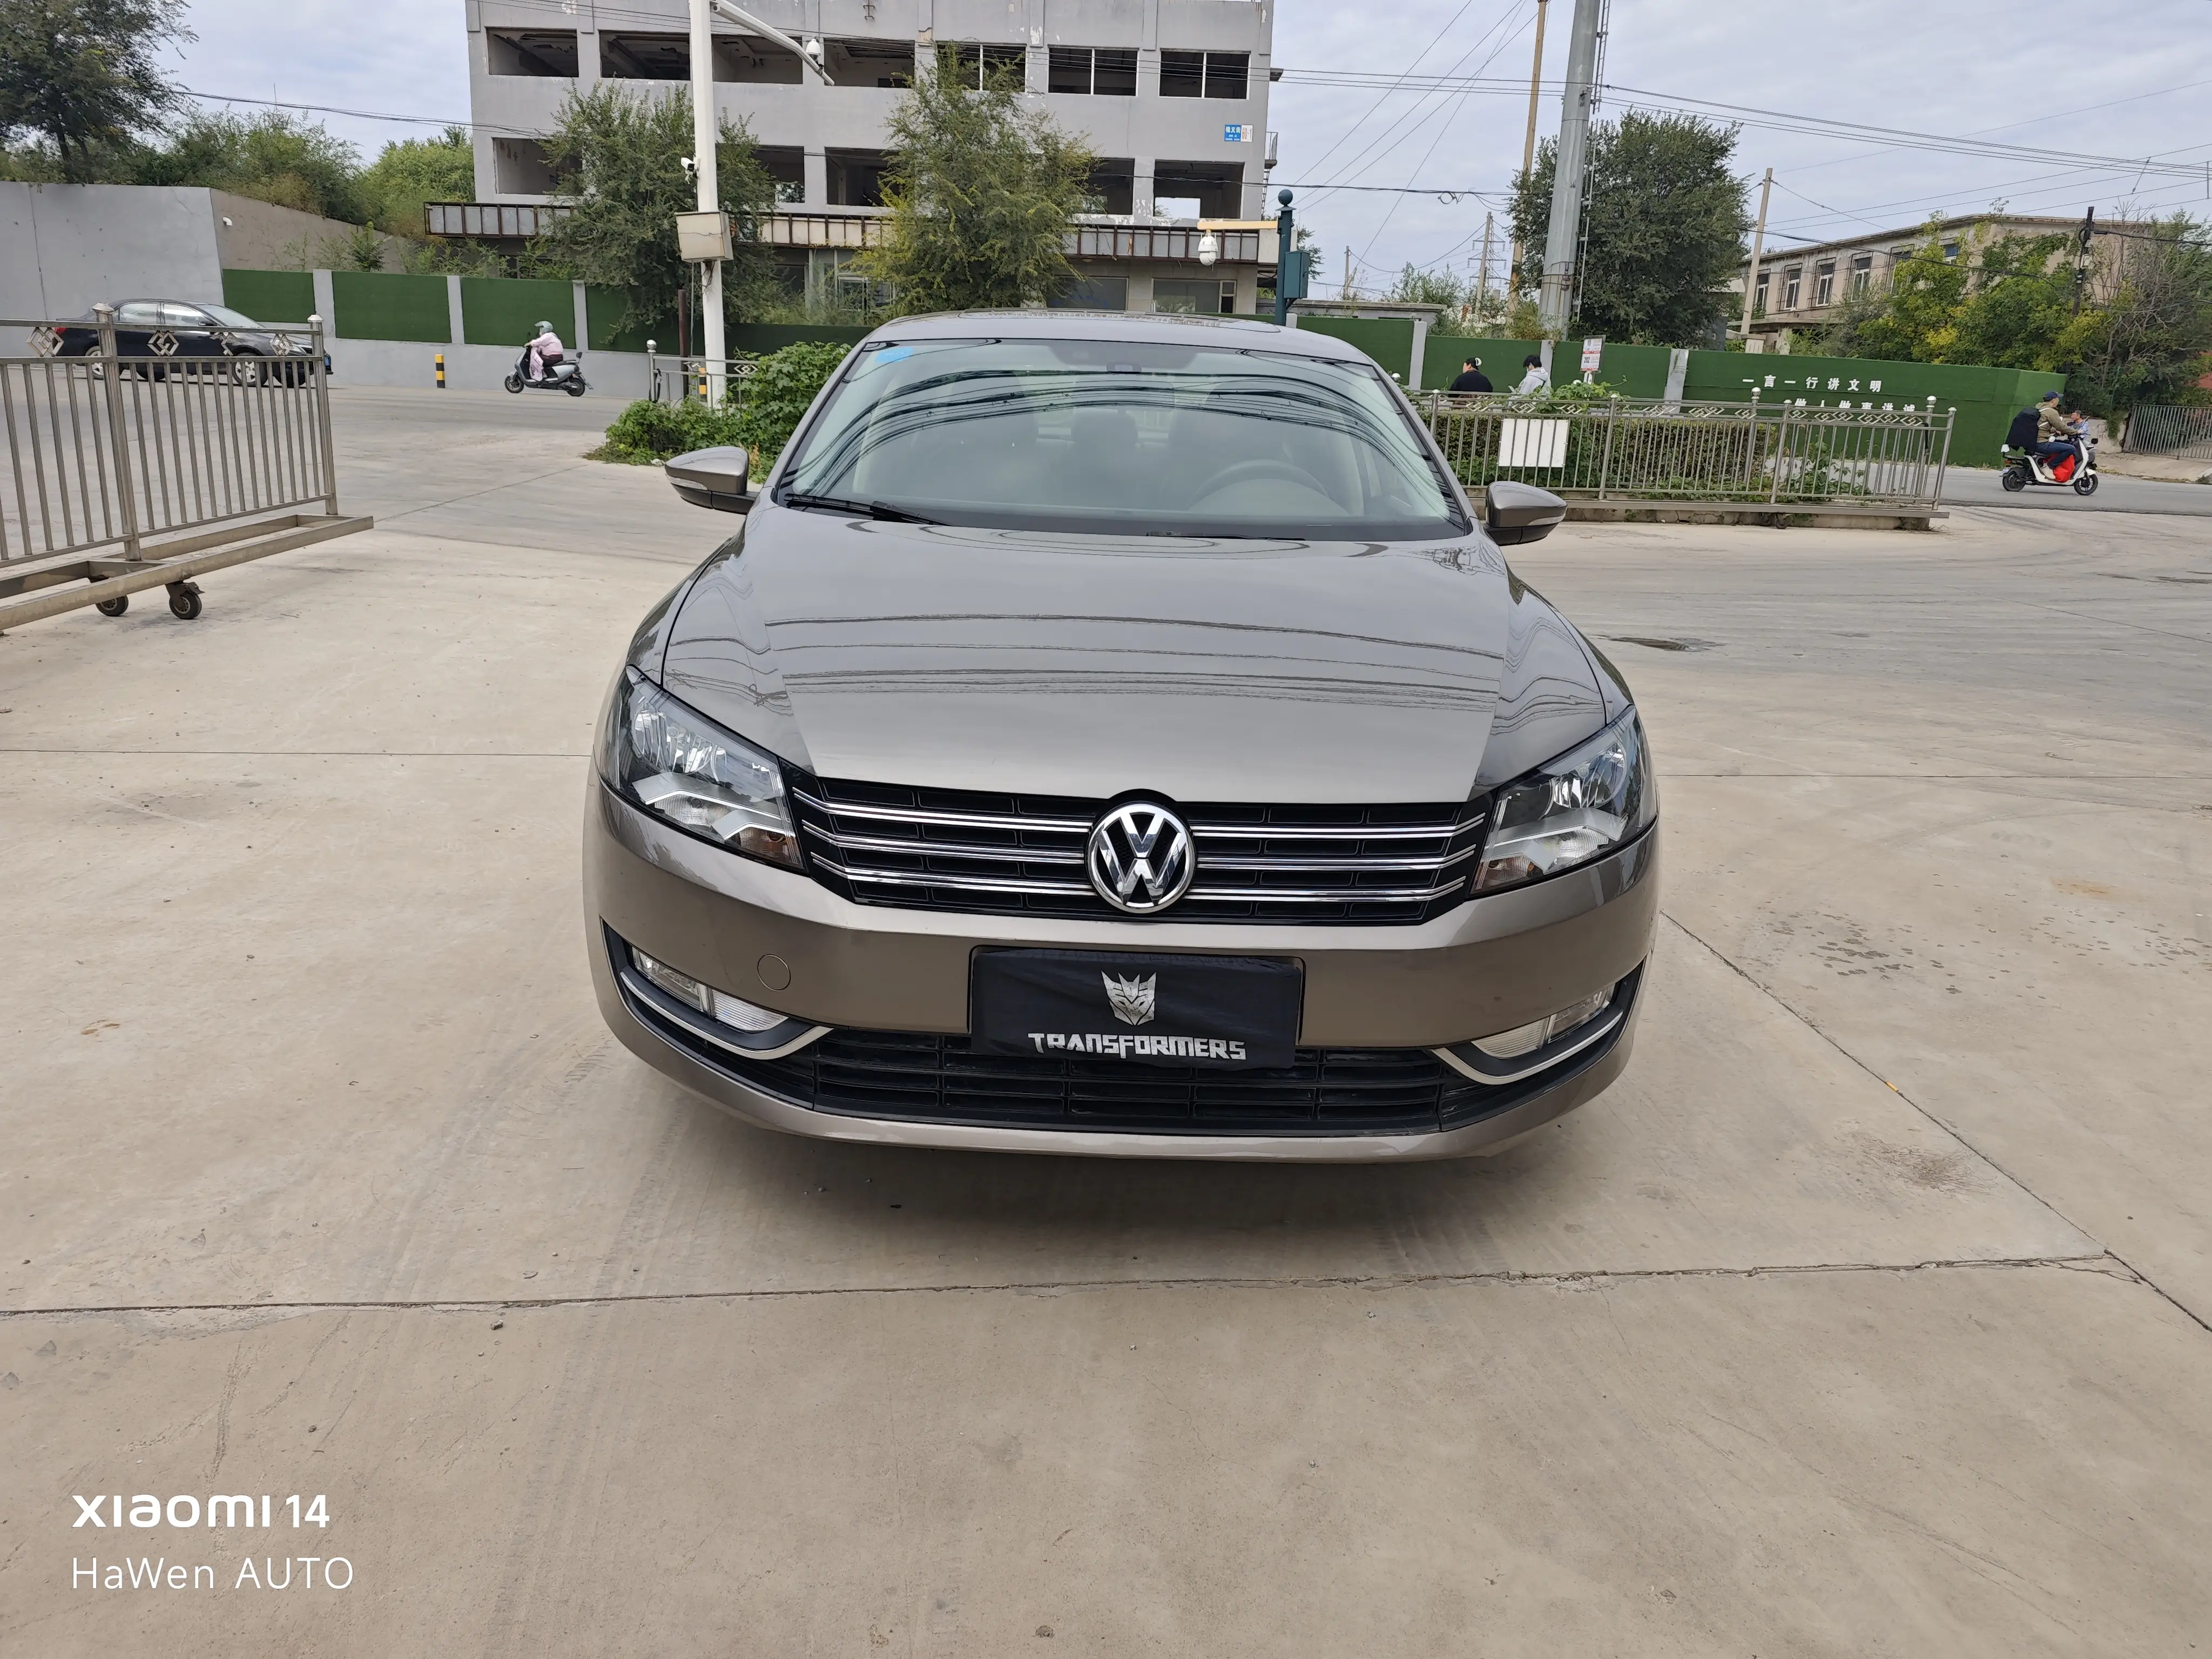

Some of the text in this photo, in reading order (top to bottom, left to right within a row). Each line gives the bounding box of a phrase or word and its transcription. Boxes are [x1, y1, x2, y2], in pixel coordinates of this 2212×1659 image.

[1242, 127, 1252, 140] 60-1
[1742, 374, 1882, 393] 一言一行讲文明
[1028, 1033, 1246, 1060] TRANSFORMERS
